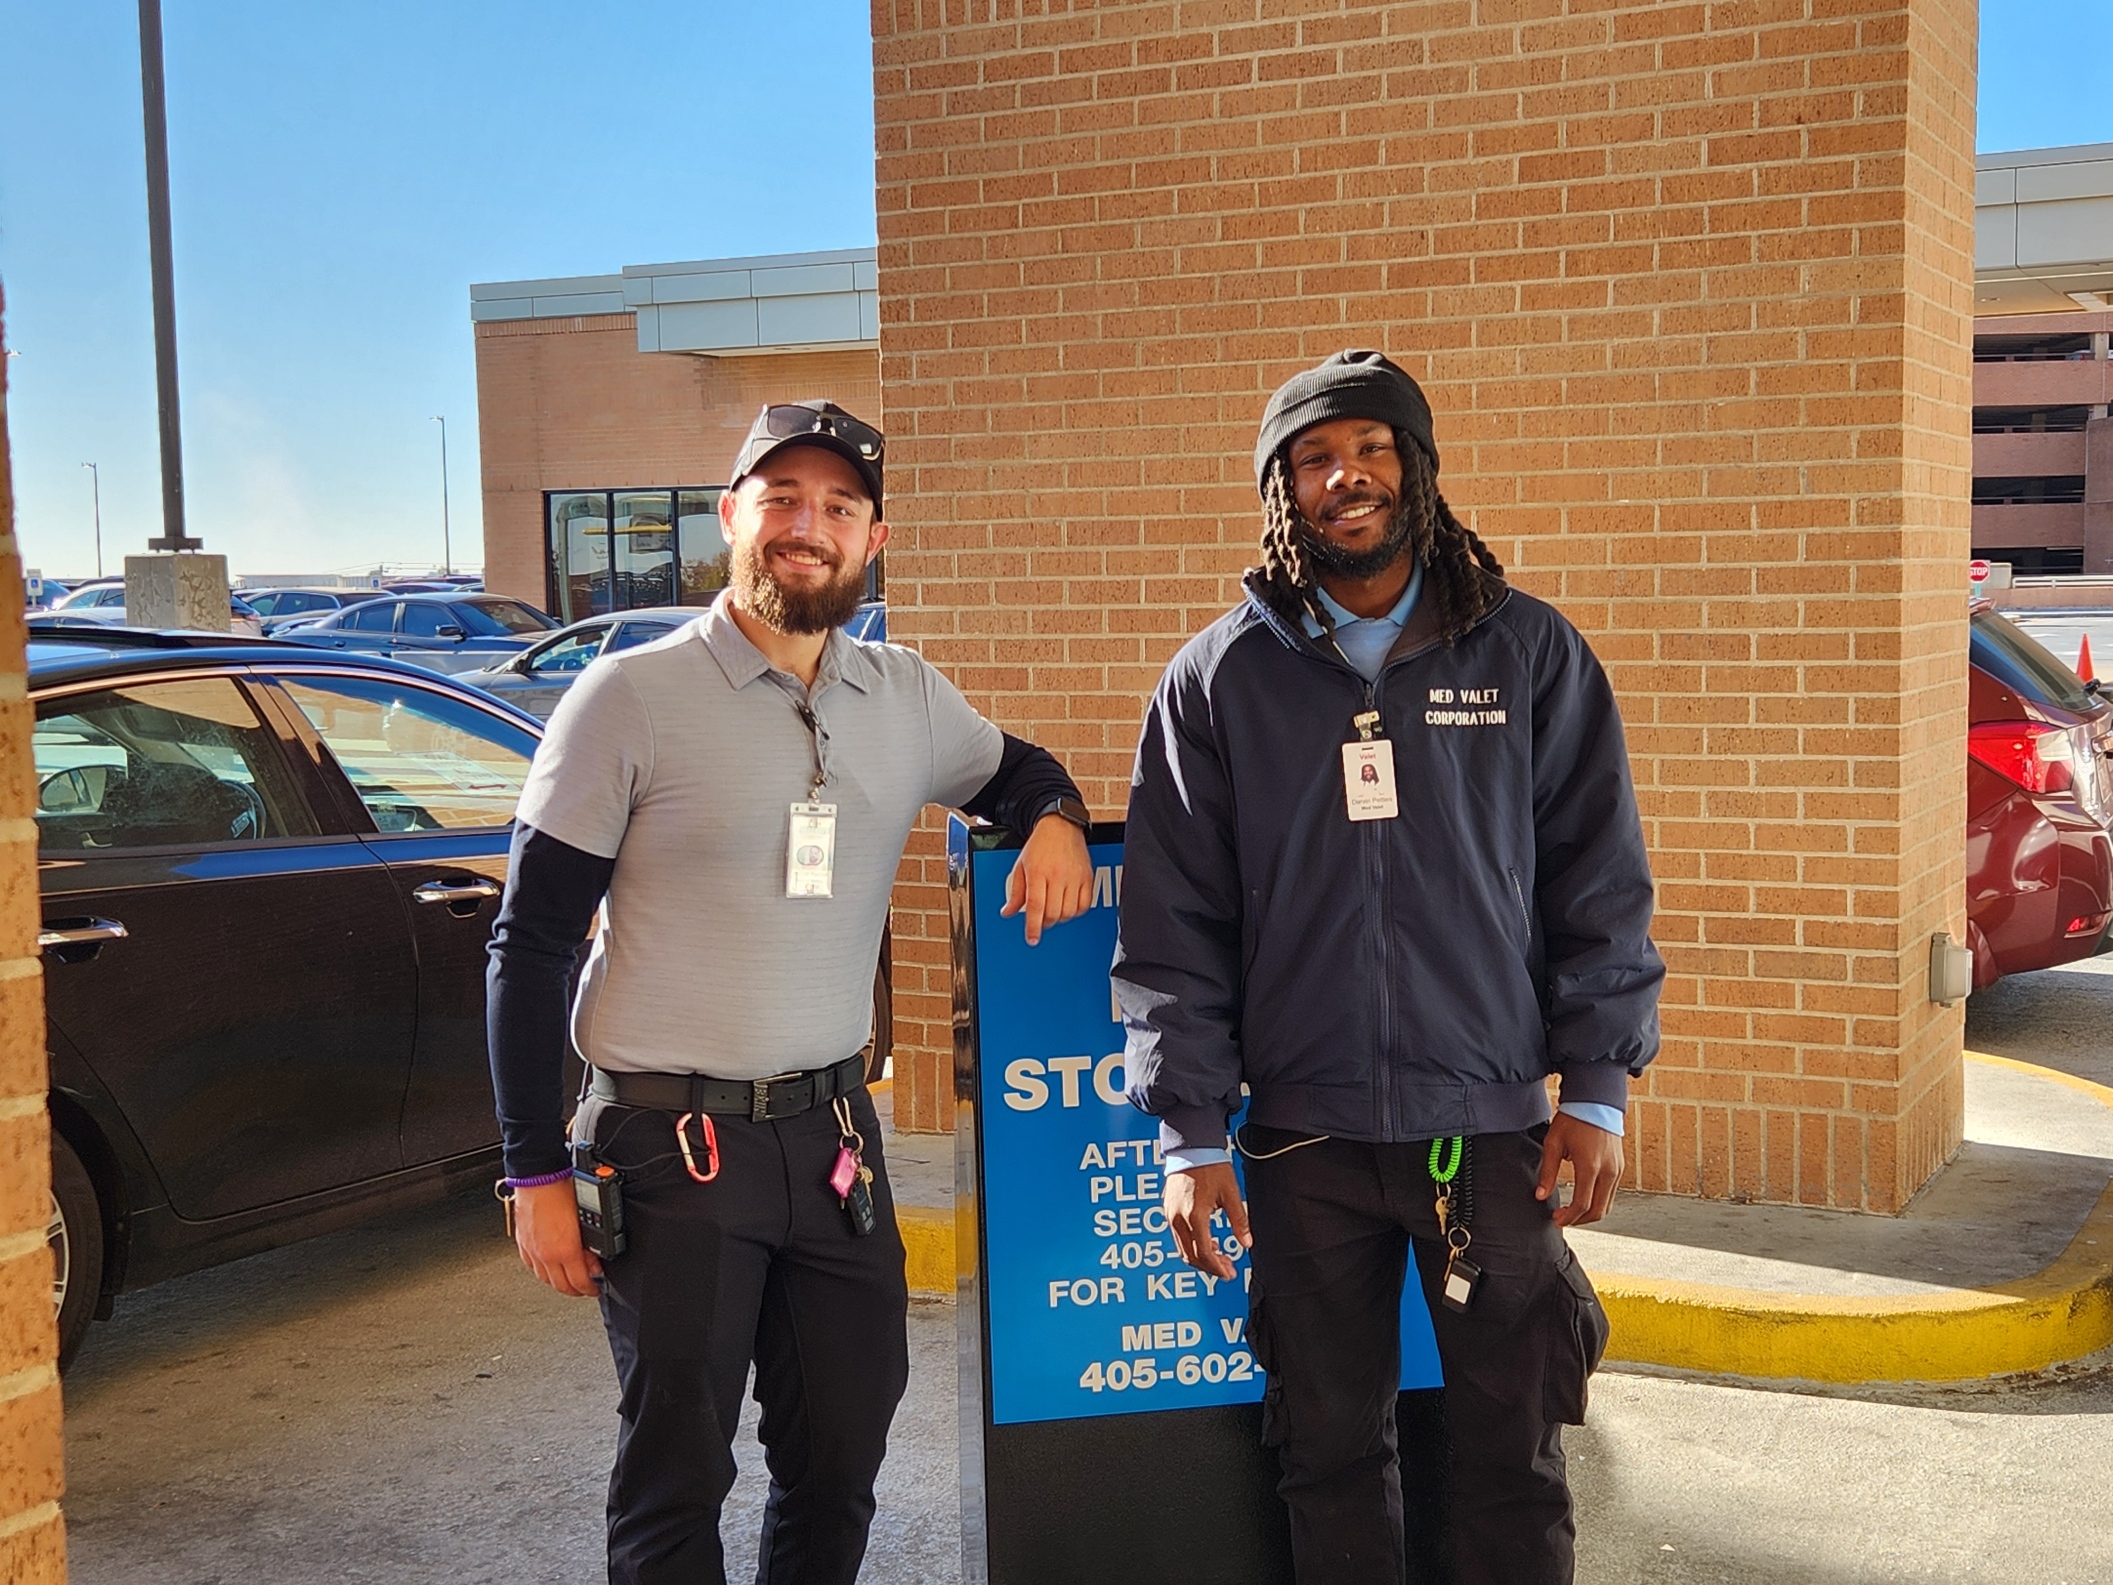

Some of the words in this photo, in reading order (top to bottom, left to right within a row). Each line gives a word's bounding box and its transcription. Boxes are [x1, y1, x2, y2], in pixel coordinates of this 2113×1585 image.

[1429, 688, 1454, 704] MED
[1460, 688, 1499, 704] VALET
[1425, 710, 1506, 726] CORPORATION
[1003, 1053, 1130, 1111] STO
[1091, 1173, 1165, 1203] PLE
[1049, 1276, 1125, 1308] FOR
[1148, 1271, 1219, 1301] KEY
[1122, 1321, 1202, 1352] MED
[1079, 1351, 1266, 1393] 405-602-
